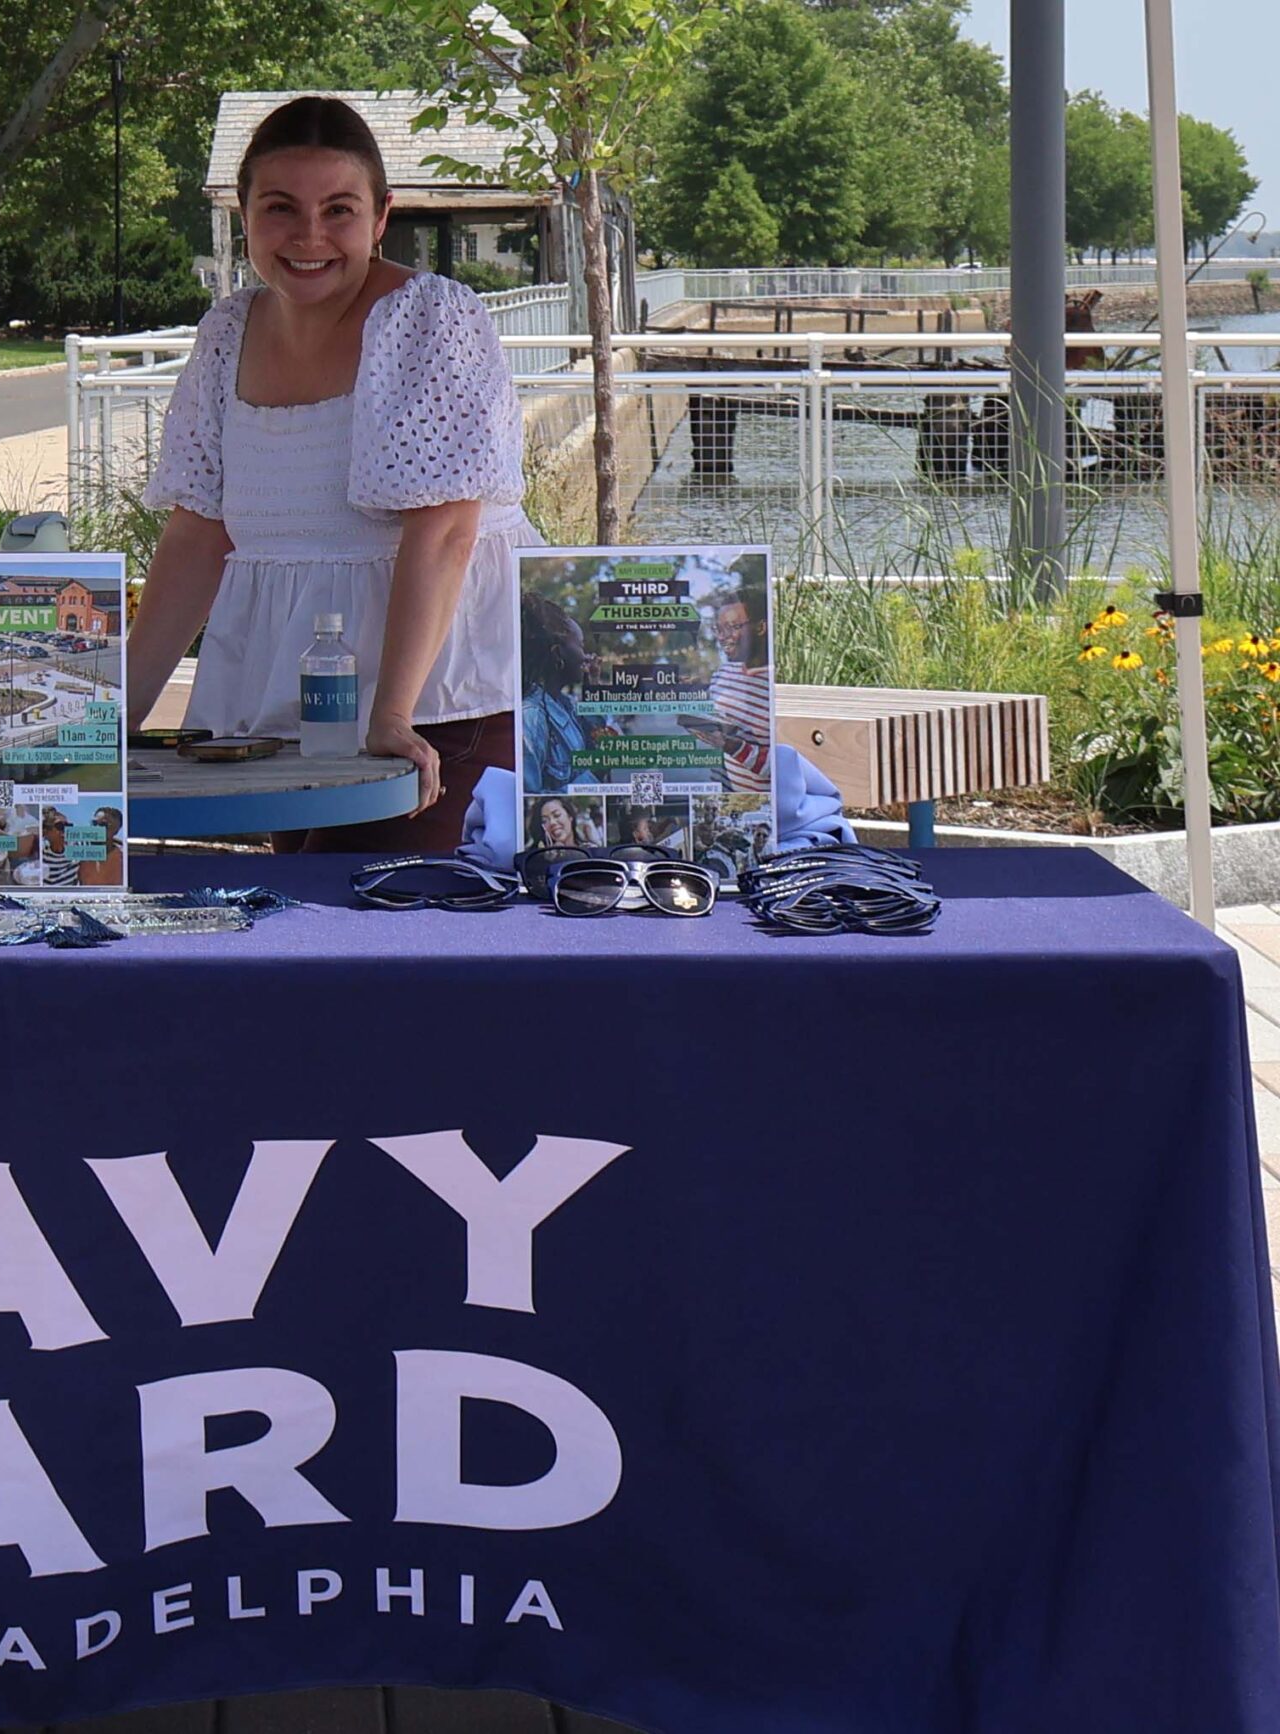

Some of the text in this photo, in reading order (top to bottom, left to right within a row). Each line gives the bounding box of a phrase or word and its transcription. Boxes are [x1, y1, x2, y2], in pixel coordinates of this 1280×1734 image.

[621, 584, 669, 595] THIRD
[601, 607, 690, 618] THURSDAYS
[615, 672, 639, 688] May
[656, 672, 676, 685] Oct
[303, 693, 323, 705] WE
[584, 689, 708, 703] 3rd Thursday of each month
[89, 707, 116, 721] July 2
[60, 730, 86, 741] 11am
[95, 730, 116, 743] 2pm
[599, 740, 614, 750] 4-7
[615, 740, 630, 750] PM
[640, 740, 670, 751] Chapel
[671, 740, 695, 750] Plaza
[572, 754, 723, 767] Food Live Music Pop-up Vendors
